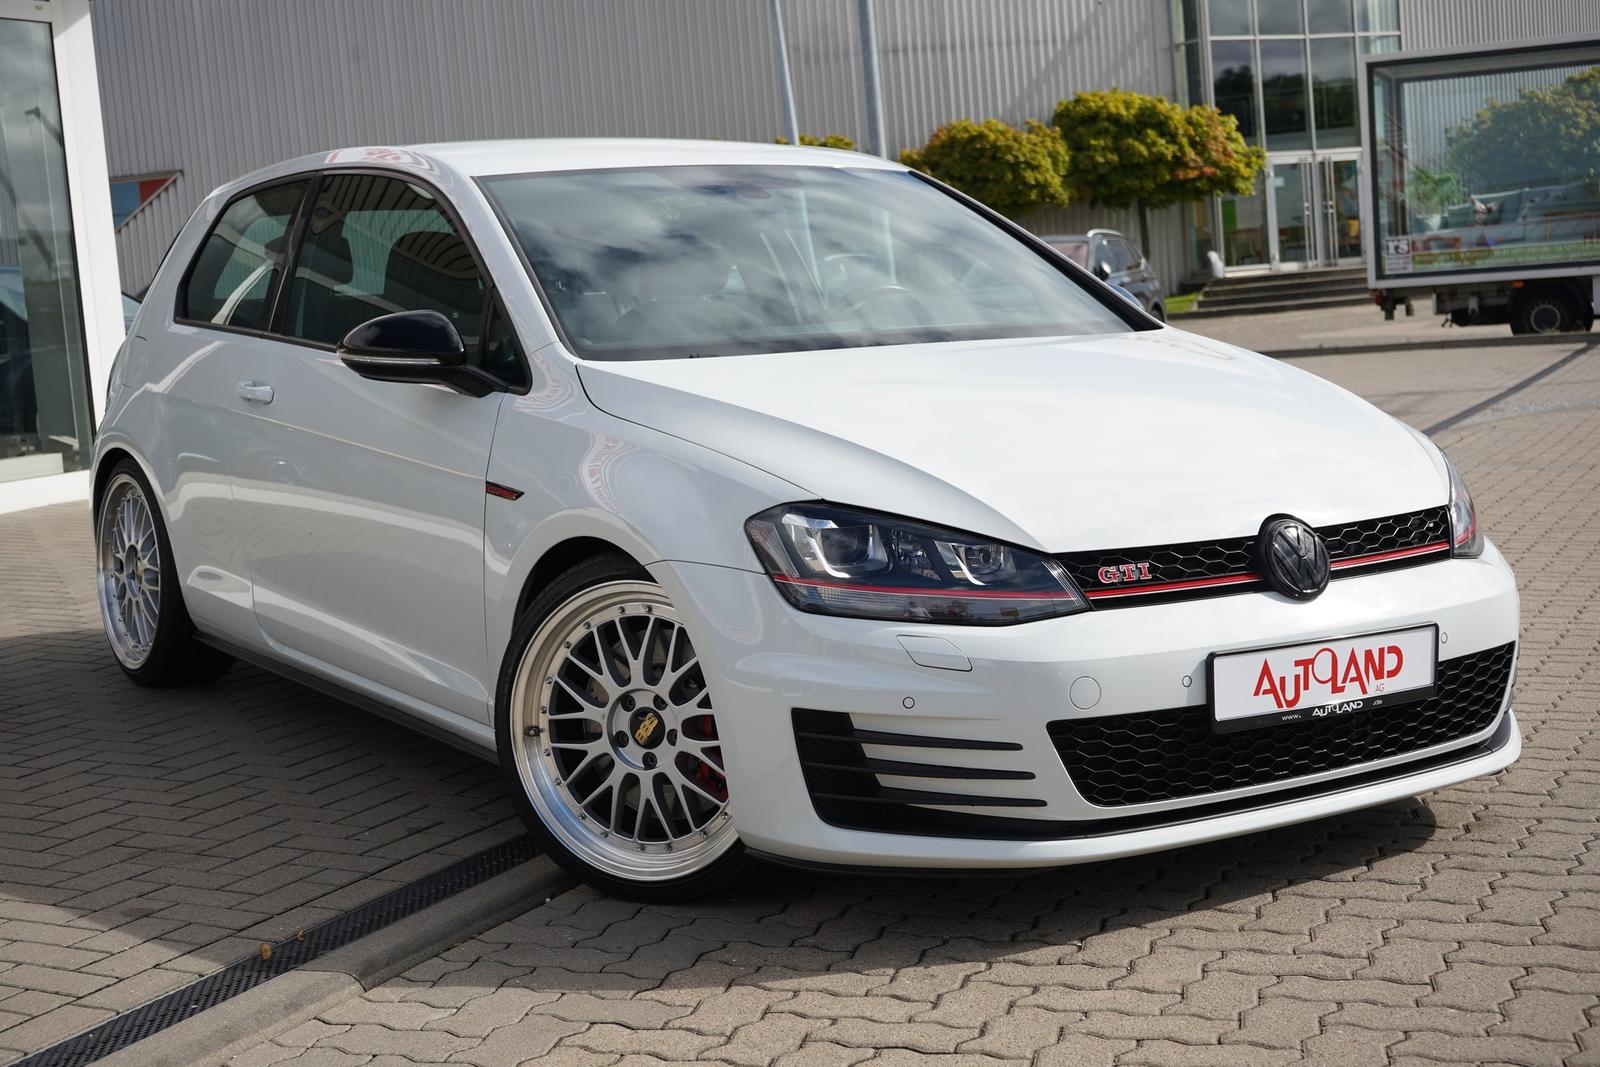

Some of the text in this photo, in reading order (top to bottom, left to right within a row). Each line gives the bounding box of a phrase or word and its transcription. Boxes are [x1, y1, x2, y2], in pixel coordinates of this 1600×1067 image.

[1098, 562, 1152, 584] GTI
[1253, 645, 1404, 709] AUTOLAND
[1375, 683, 1385, 693] AG
